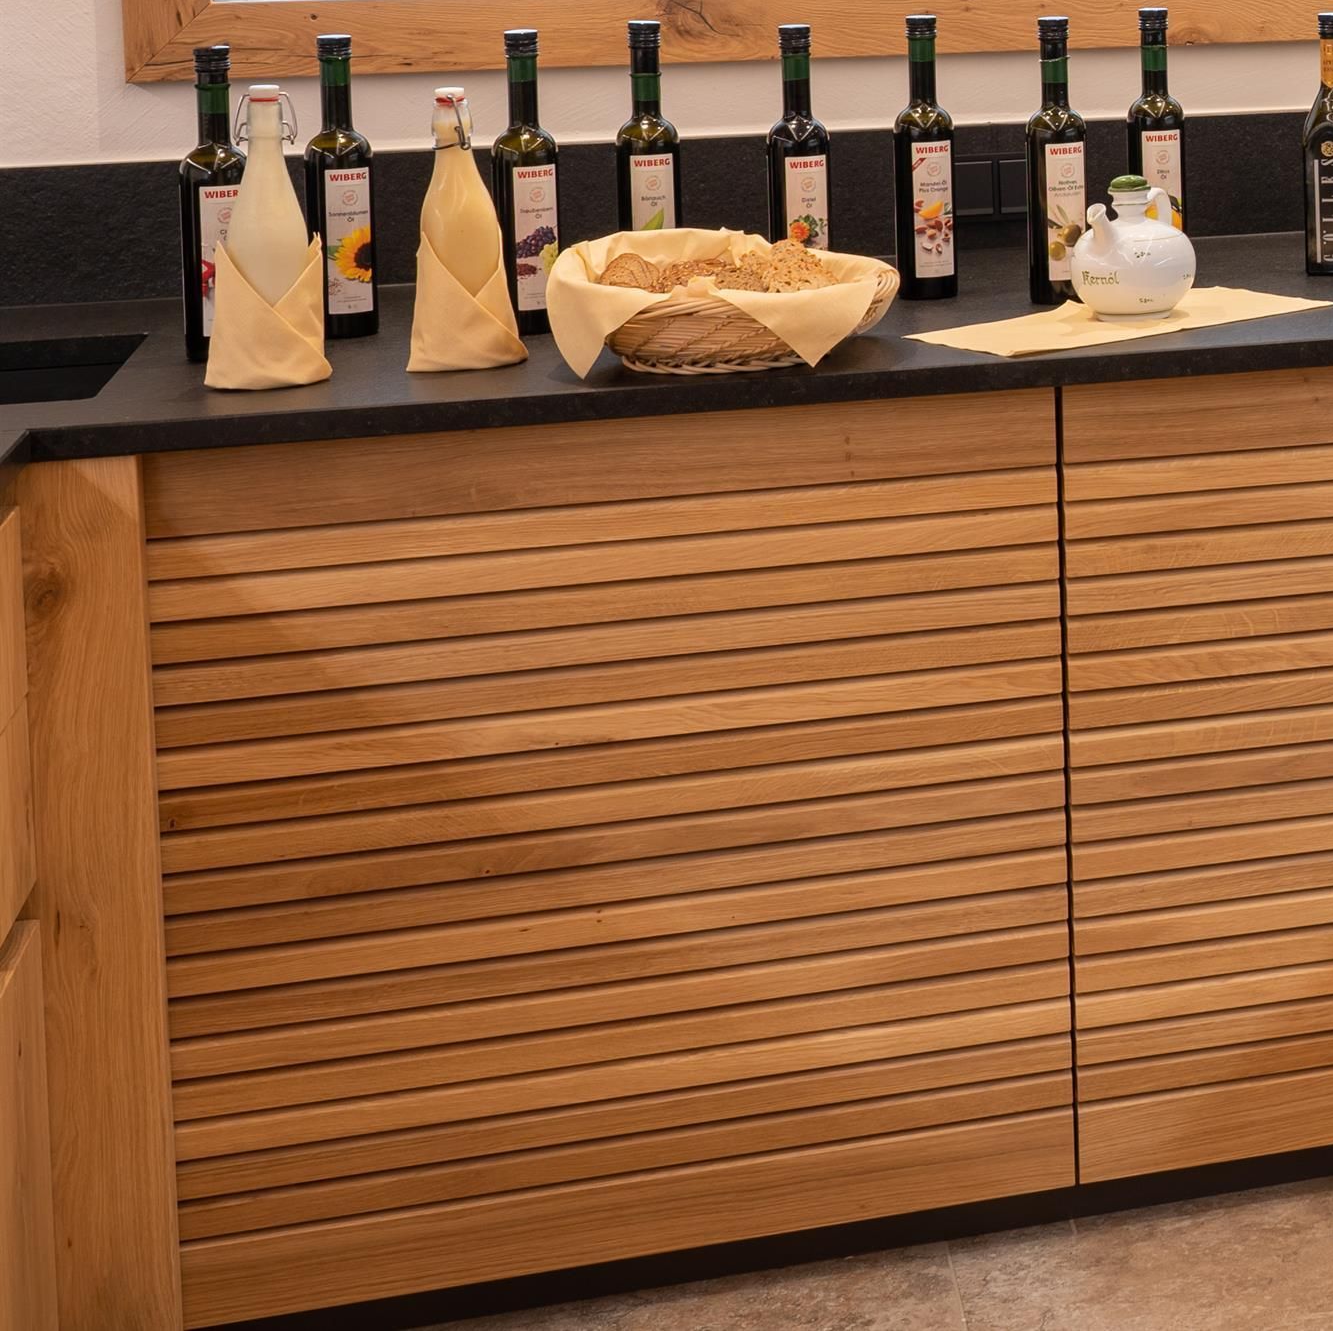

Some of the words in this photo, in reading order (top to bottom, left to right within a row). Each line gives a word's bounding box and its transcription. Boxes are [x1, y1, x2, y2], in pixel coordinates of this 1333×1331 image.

[1145, 133, 1178, 143] WIBERG
[915, 144, 949, 155] WIBERG
[1049, 145, 1082, 156] WIBERG
[633, 157, 671, 167] WIBERG
[789, 159, 825, 169] WIBERG
[329, 171, 367, 182] WIBERG
[516, 168, 554, 179] WIBERG
[204, 189, 239, 199] WIBER
